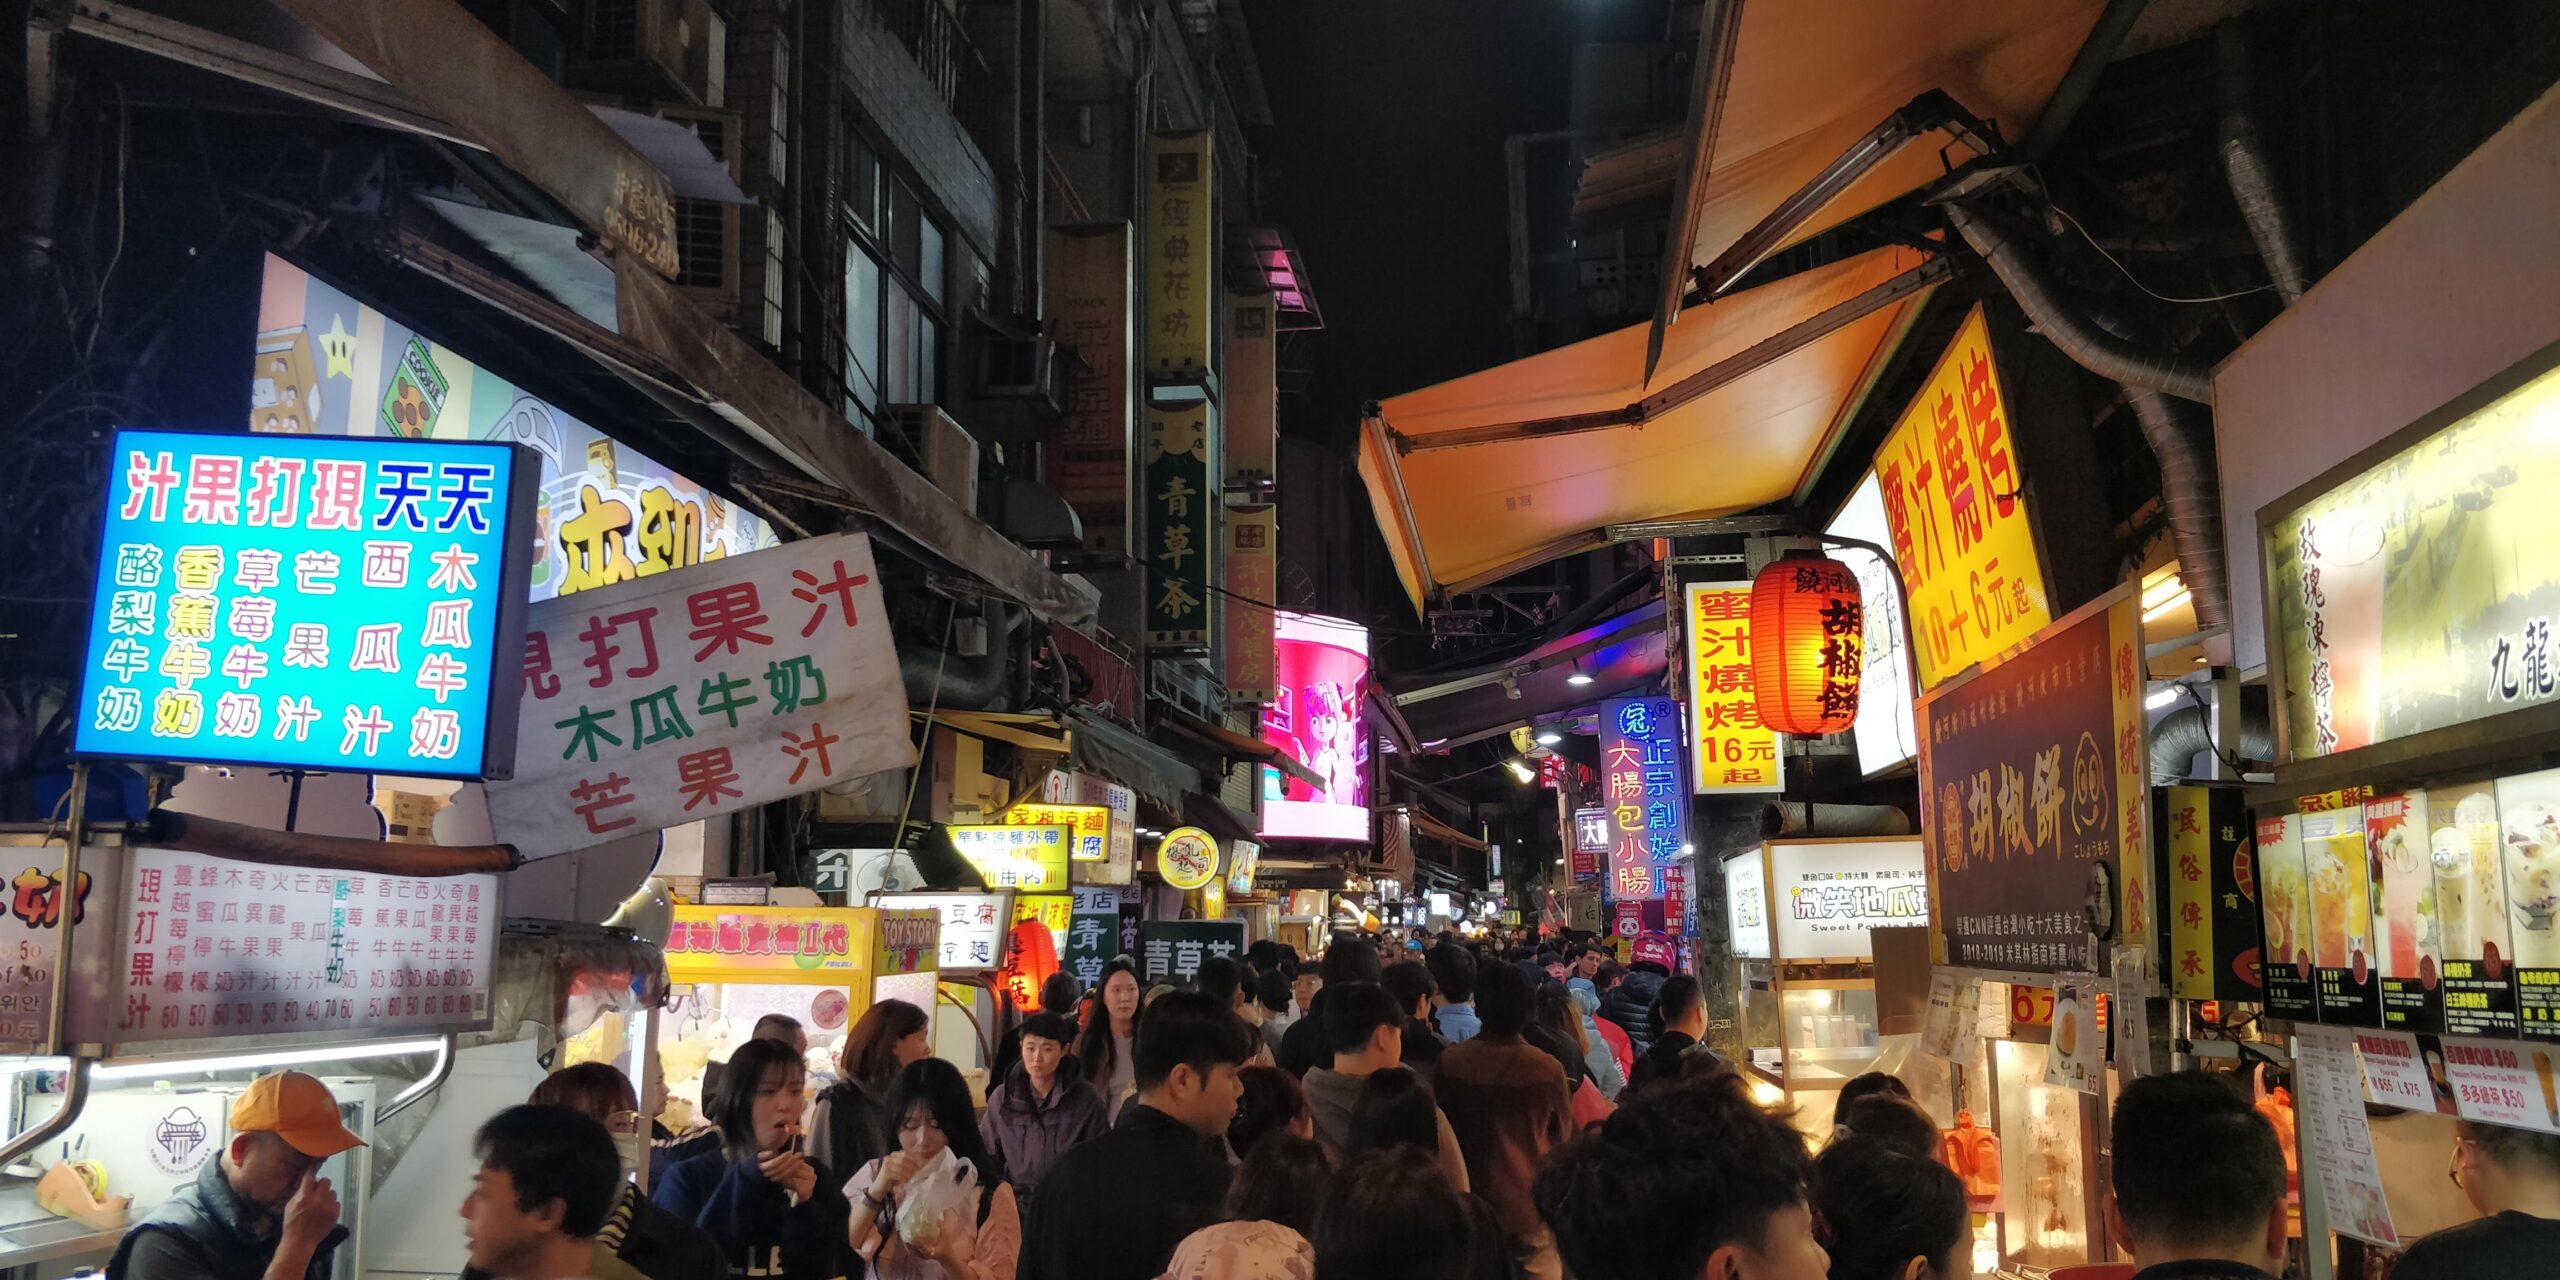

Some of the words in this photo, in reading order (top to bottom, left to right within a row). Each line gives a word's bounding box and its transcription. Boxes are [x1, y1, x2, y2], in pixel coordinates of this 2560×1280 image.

[1883, 346, 2014, 600] 蜜汁燒烤
[1157, 476, 1199, 620] 青草茶
[97, 542, 162, 730] 酪梨牛奶
[152, 546, 222, 737] 香蕉牛奶
[214, 548, 281, 737] 草莓牛奶
[274, 551, 340, 740] 芒果汁
[341, 541, 412, 756] 西瓜汁
[409, 544, 479, 758] 木瓜牛奶
[1700, 591, 1765, 730] 蜜汁燒烤
[1817, 599, 1861, 720] 胡椒餅
[555, 654, 827, 761] 木瓜牛奶
[1626, 707, 1649, 734] 冠
[1702, 737, 1775, 763] 16元
[571, 723, 839, 833] 芒果汁
[1608, 739, 1650, 894] 大腸包小腸
[1723, 768, 1762, 783] 起
[1967, 743, 2065, 861] 胡椒餅
[2115, 642, 2144, 934] 傳統美食
[1070, 836, 1102, 856] 腐
[2179, 807, 2205, 978] 民俗傳承
[127, 869, 162, 1029] 現打果汁
[164, 865, 193, 993] 蔓越莓檸檬
[190, 867, 219, 993] 蜂蜜檸檬
[215, 869, 243, 992] 木瓜牛奶
[239, 870, 266, 991] 奇異果汁
[262, 872, 289, 991] 火龍果汁
[285, 873, 311, 990] 芒果汁
[307, 874, 331, 990] 西瓜汁
[326, 879, 349, 984] 酪梨牛奶
[341, 877, 366, 990] 草莓牛奶
[370, 878, 393, 989] 香蕉牛奶
[388, 879, 412, 988] 芒果牛奶
[407, 881, 430, 988] 西瓜牛奶
[426, 882, 448, 988] 火龍果牛奶
[443, 883, 465, 987] 奇異果牛奶
[460, 884, 481, 987] 蔓越莓牛奶
[884, 919, 904, 950] TOY
[907, 919, 937, 949] STORY
[1812, 923, 1851, 932] Sweet
[306, 1001, 320, 1021] 40
[325, 999, 336, 1018] 70
[341, 999, 353, 1019] 60
[369, 997, 381, 1017] 50
[2495, 1048, 2519, 1069] $60
[2378, 1078, 2394, 1093] $55
[2404, 1081, 2421, 1097] $75
[2502, 1087, 2524, 1109] $50
